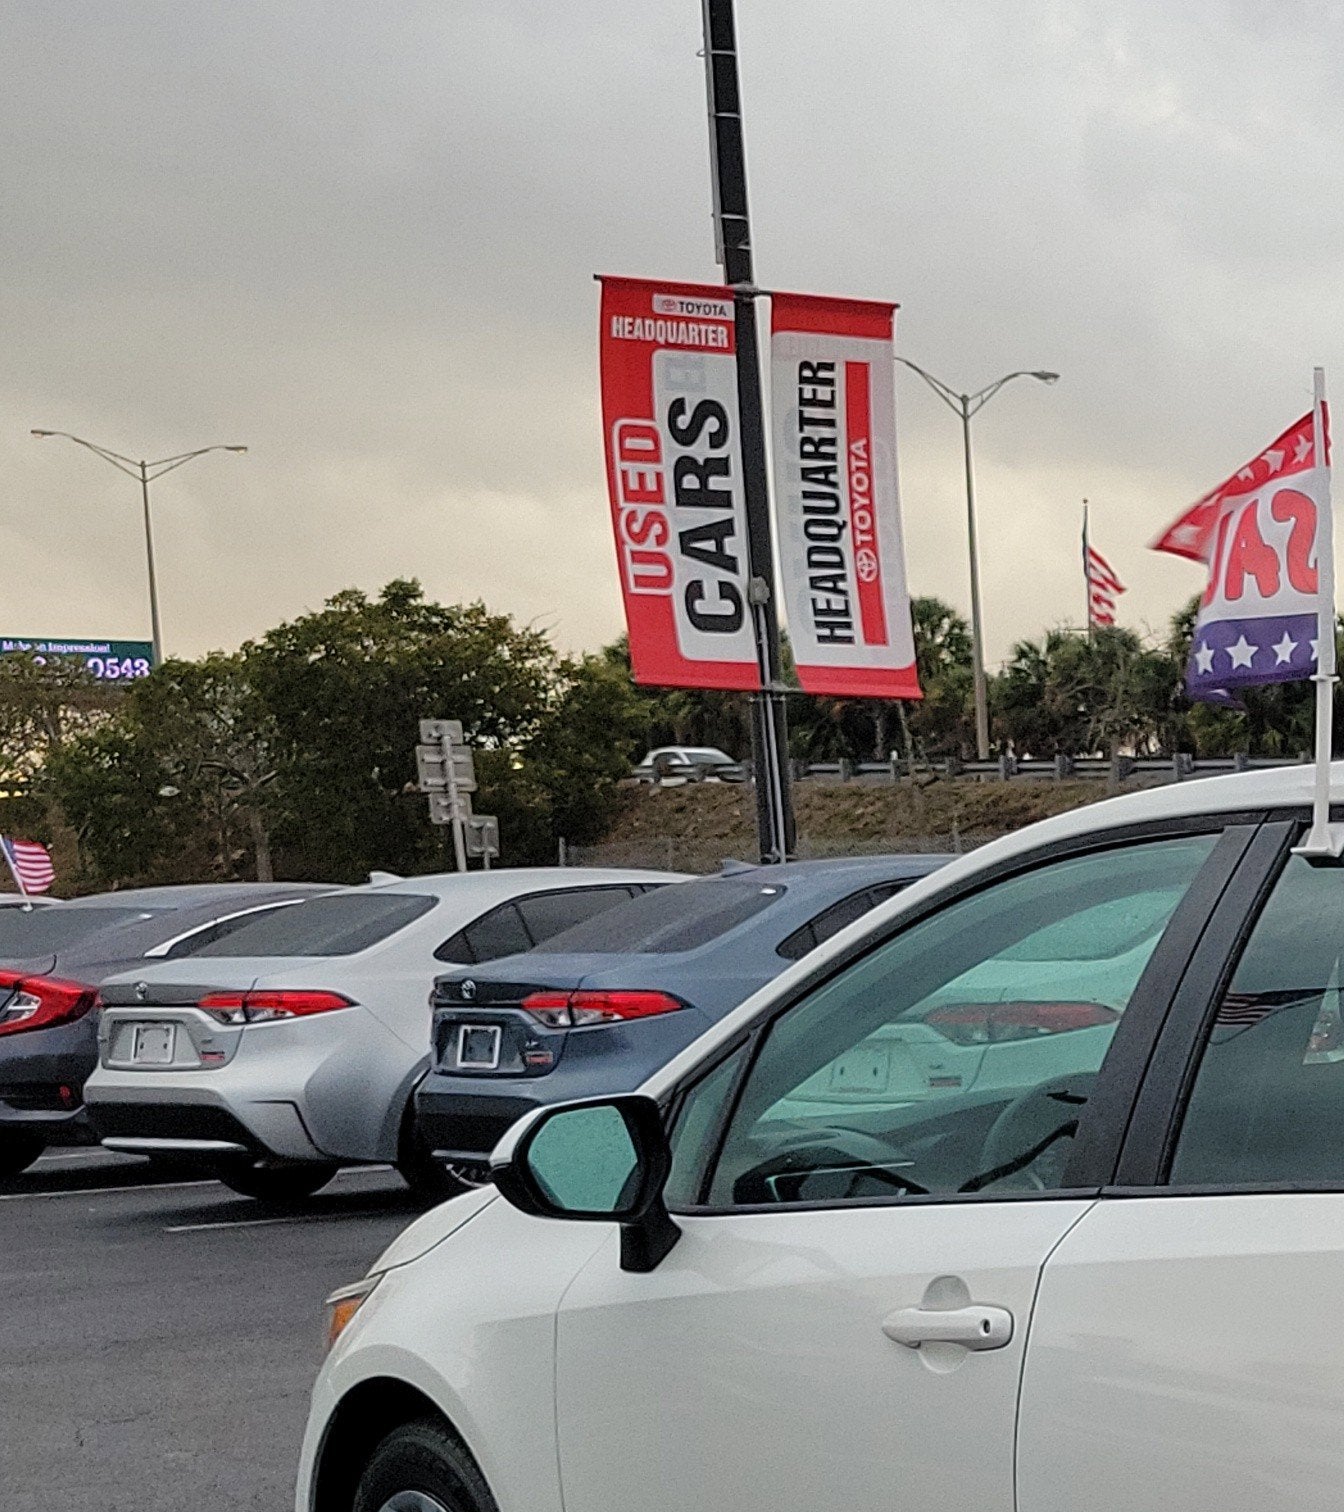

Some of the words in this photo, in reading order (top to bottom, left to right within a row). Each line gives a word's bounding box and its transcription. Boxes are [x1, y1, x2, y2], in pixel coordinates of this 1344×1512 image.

[610, 315, 730, 349] HEADQUARTER
[679, 301, 728, 317] TOYOTA
[616, 422, 674, 594] USED
[667, 396, 745, 634] CARS
[798, 360, 855, 646] HEADQUARTER
[850, 437, 873, 546] TOYOTA
